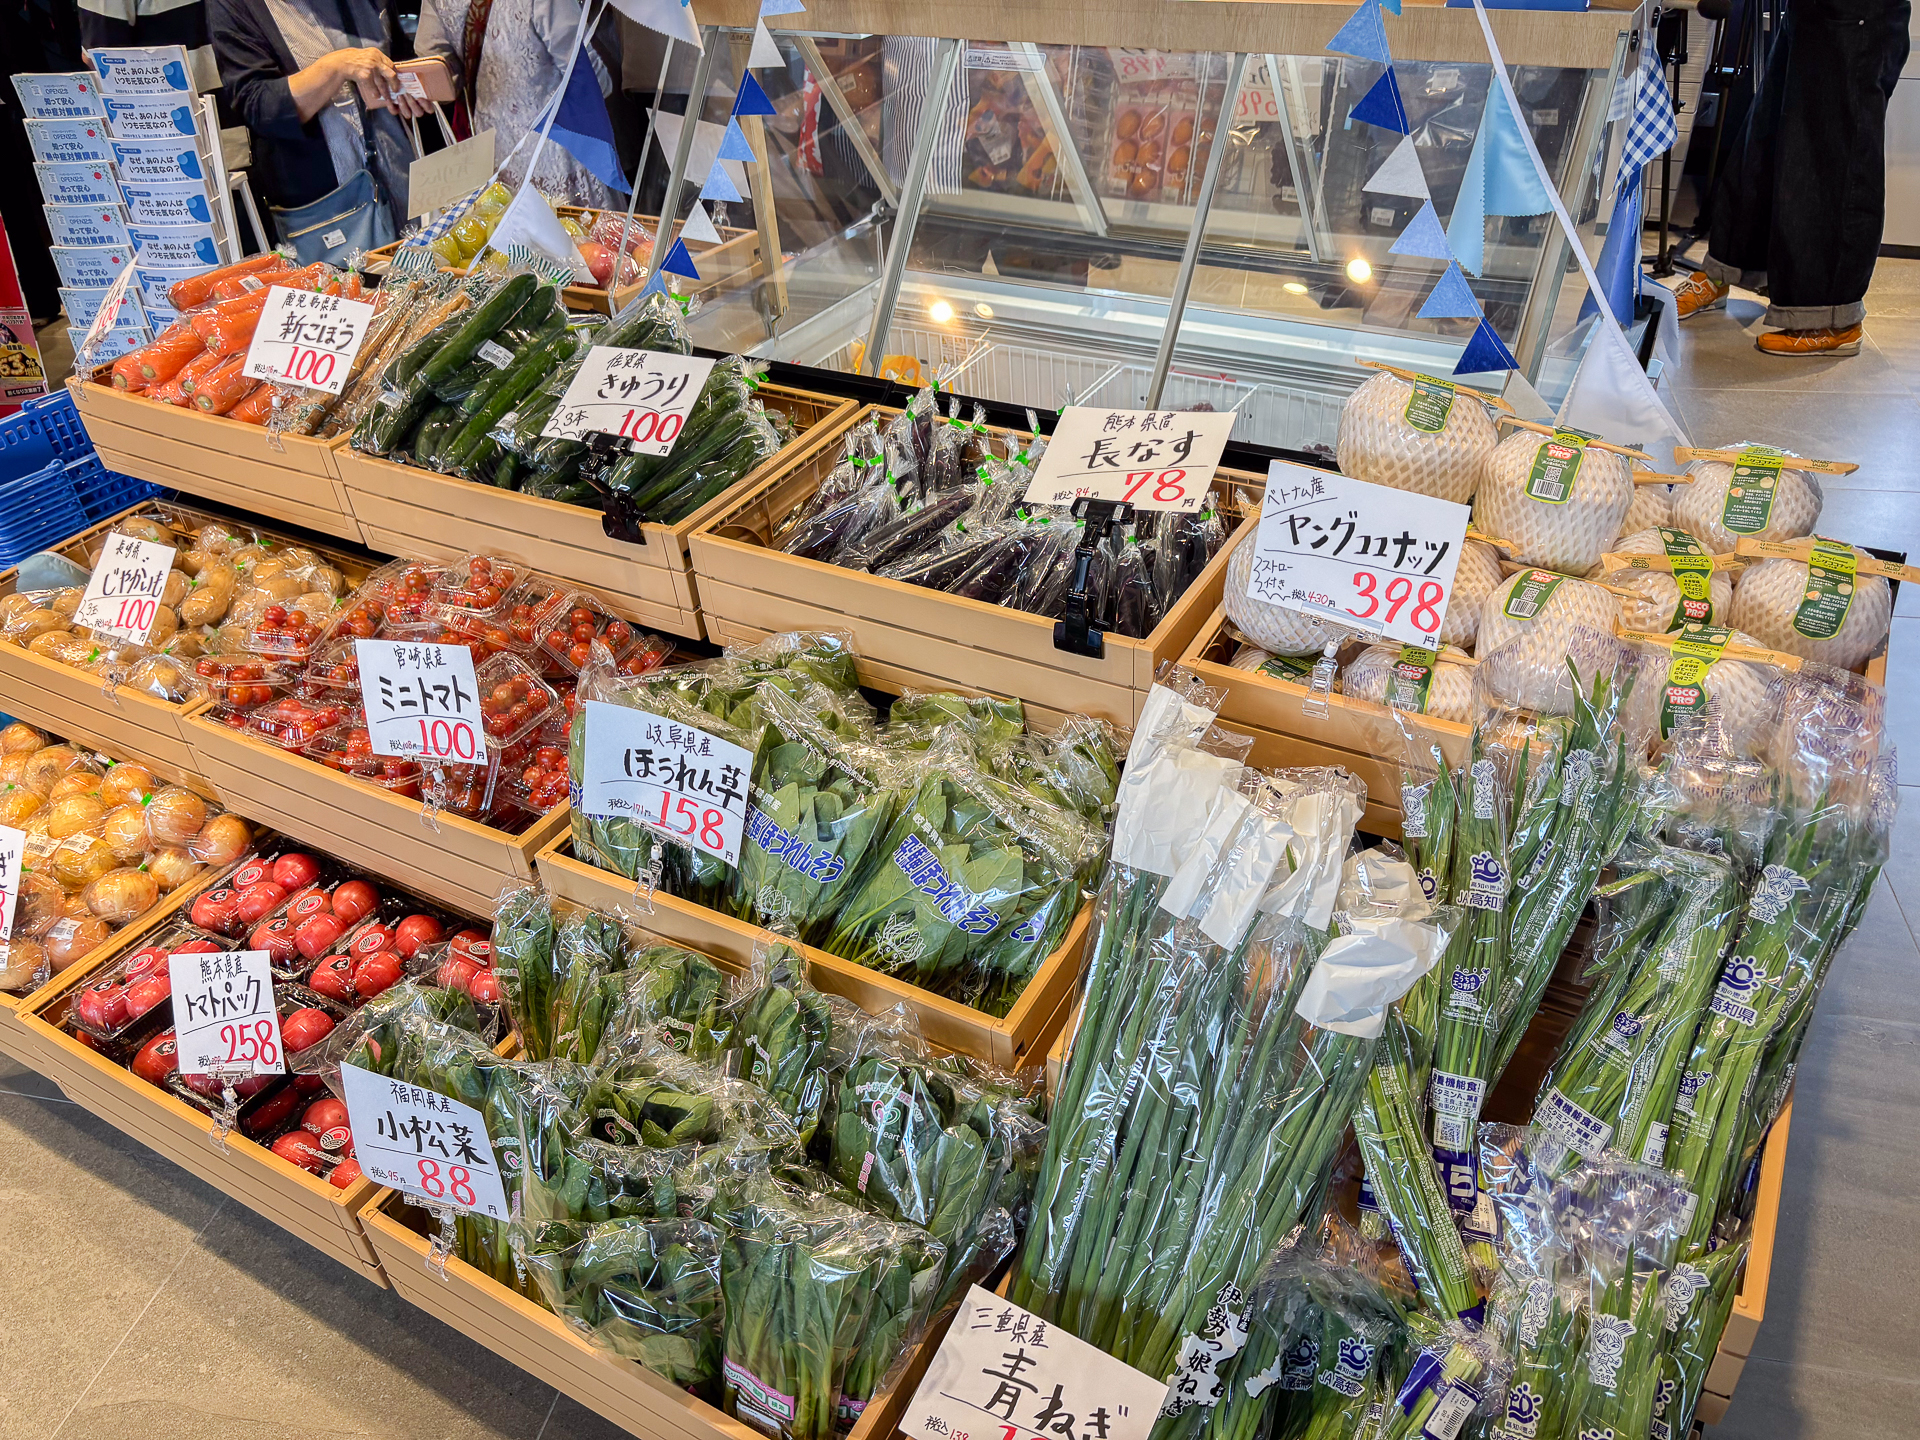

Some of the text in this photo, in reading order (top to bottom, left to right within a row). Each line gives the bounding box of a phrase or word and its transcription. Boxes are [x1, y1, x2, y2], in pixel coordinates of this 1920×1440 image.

[115, 67, 160, 76] なぜ、あの人は
[44, 97, 76, 106] 知って安心
[122, 112, 168, 120] なぜ、あの人は
[52, 142, 84, 150] 知って安心
[129, 156, 175, 166] なぜ、あの人は
[60, 185, 91, 193] 知って安心
[139, 200, 184, 209] なぜ、あの人は
[68, 227, 100, 235] 知って安心
[77, 268, 109, 277] 知って安心
[279, 311, 354, 351] 新ごぼう
[606, 352, 647, 370] 佐賀県
[597, 373, 689, 407] きゅうり
[563, 410, 589, 427] 3本
[1102, 412, 1176, 433] 熊本県産
[1080, 429, 1203, 470] 長なす
[1547, 443, 1578, 454] COCO
[1548, 450, 1572, 460] PRO
[1267, 476, 1325, 506] ベトナム産
[1280, 510, 1450, 575] ヤングココナッツ
[1262, 560, 1294, 573] ストロー
[103, 557, 163, 598] じゃがいも
[1263, 577, 1286, 591] 付き
[1683, 600, 1710, 611] COCO
[1685, 608, 1706, 618] PRO
[393, 645, 447, 669] 宮崎県産
[1398, 663, 1428, 674] COCO
[379, 675, 472, 715] ミニトマト
[1667, 687, 1700, 698] COCO
[1669, 695, 1697, 705] PRO
[646, 722, 714, 757] 岐阜県産
[624, 748, 746, 809] ほうれん草
[200, 954, 248, 984] 熊本県産
[1454, 973, 1476, 983] こうちの
[185, 975, 261, 1022] トマトパック
[390, 1081, 458, 1114] 福岡県産
[1549, 1093, 1603, 1134] 栄養機能食品
[378, 1110, 489, 1165] 小松菜
[971, 1307, 1049, 1349] 三重県産
[982, 1348, 1129, 1440] 青ねぎ
